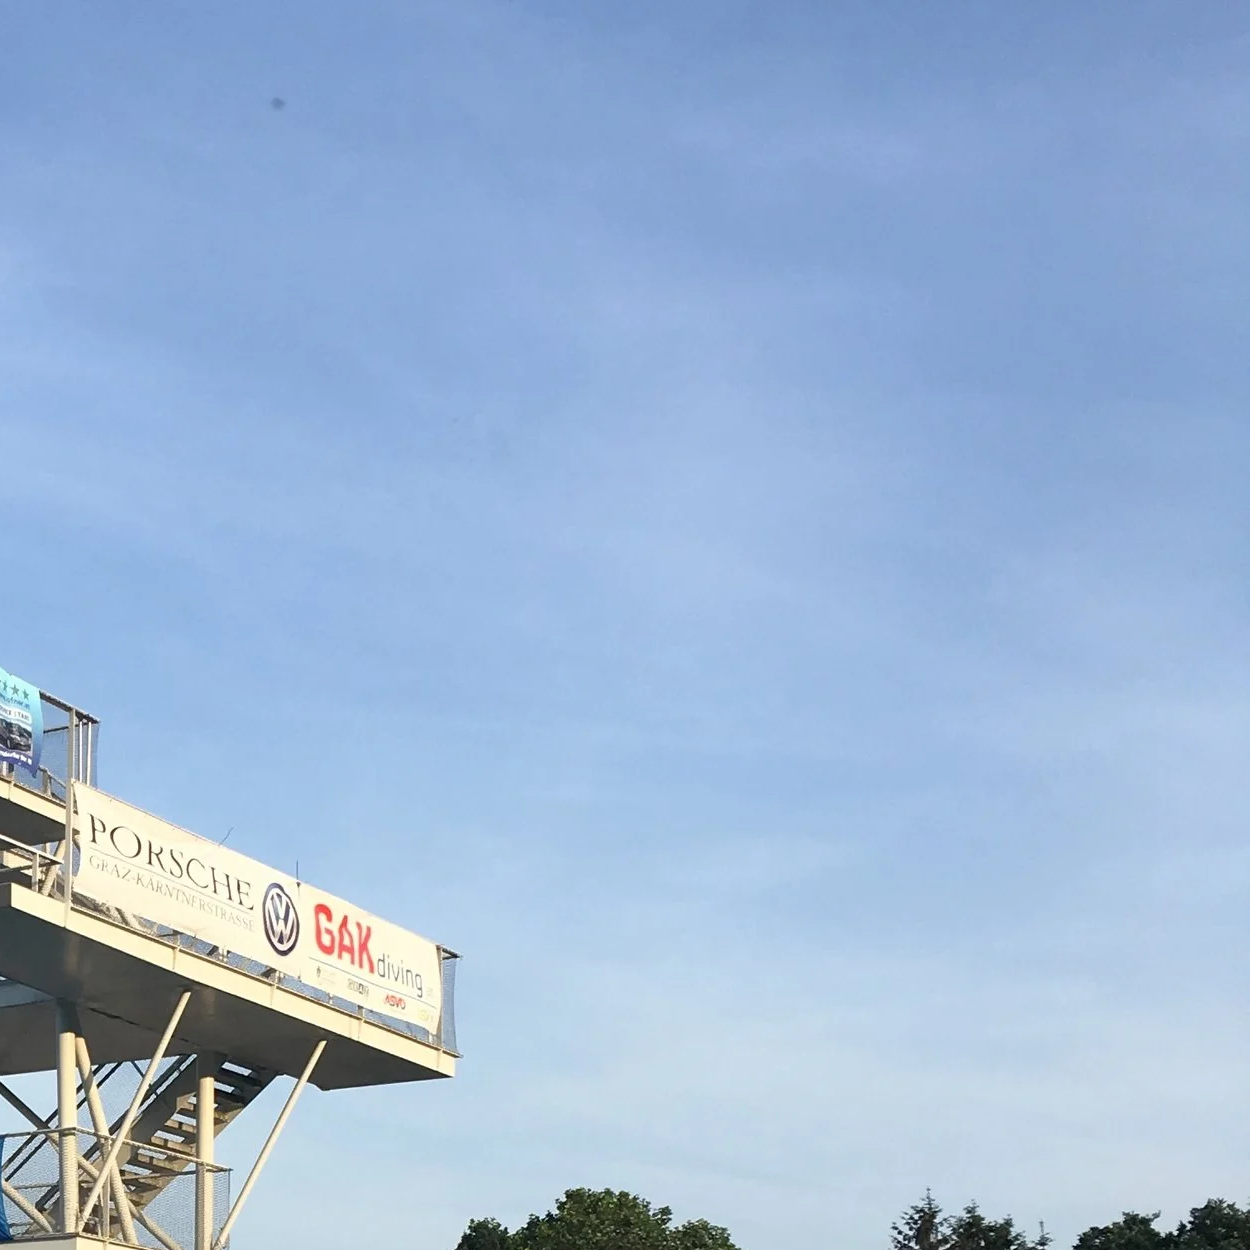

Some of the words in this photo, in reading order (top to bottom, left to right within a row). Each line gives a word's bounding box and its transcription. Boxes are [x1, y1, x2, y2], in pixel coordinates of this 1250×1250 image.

[88, 812, 255, 911] PORSCHE
[314, 903, 375, 975] GAK
[377, 952, 423, 998] diving
